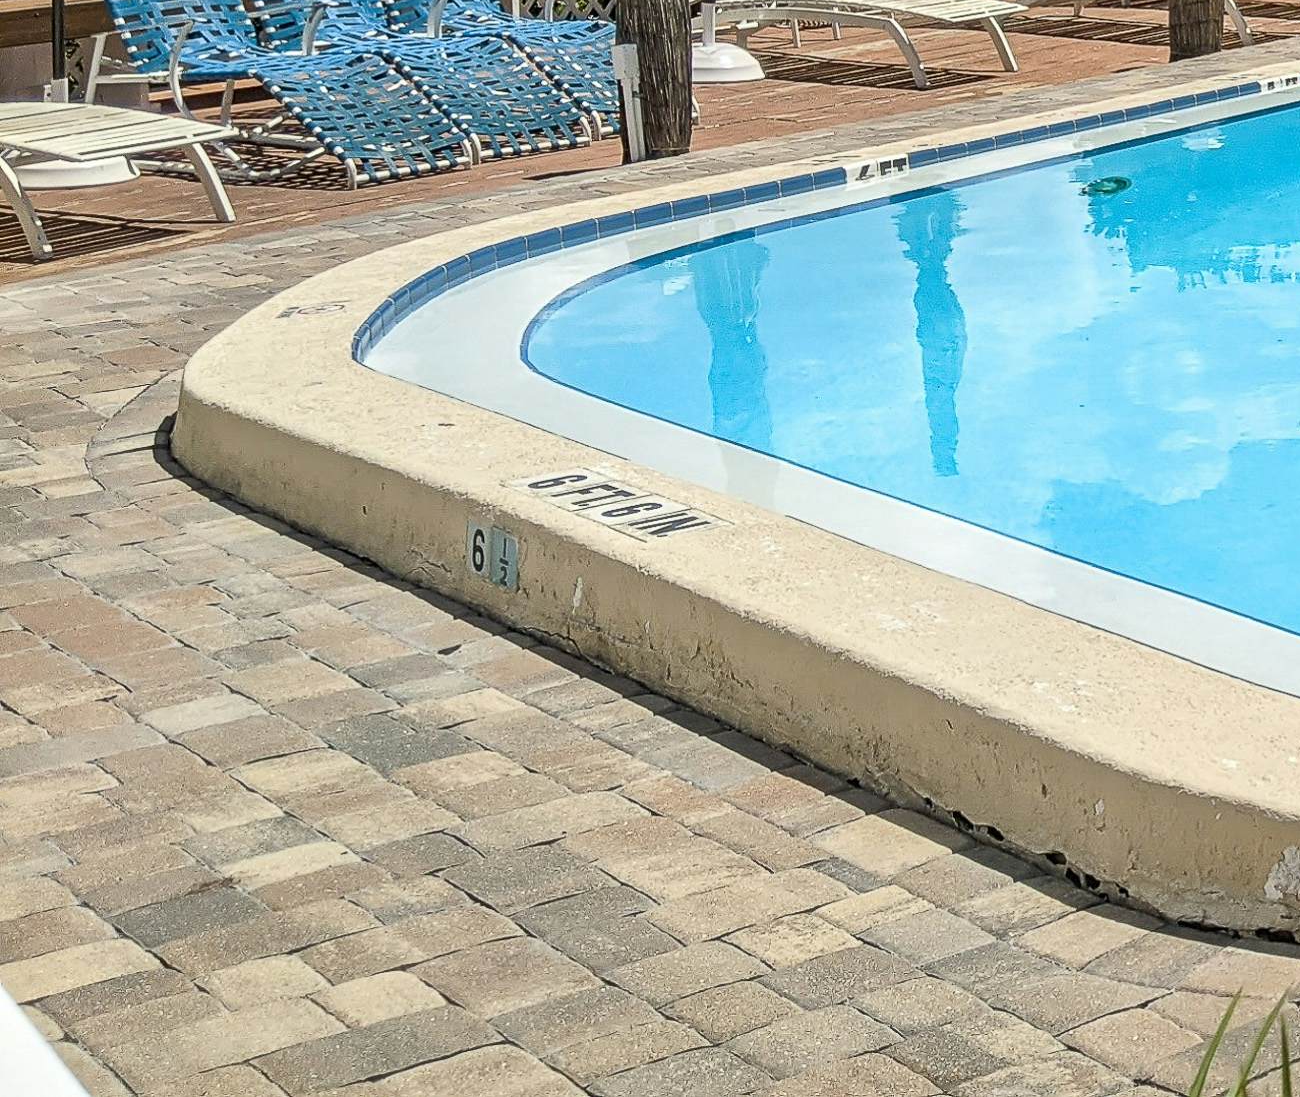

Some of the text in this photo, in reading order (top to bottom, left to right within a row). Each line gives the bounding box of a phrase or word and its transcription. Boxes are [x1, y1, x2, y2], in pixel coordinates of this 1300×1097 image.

[527, 474, 588, 489] 6
[600, 502, 663, 518] 6
[472, 528, 486, 573] 6
